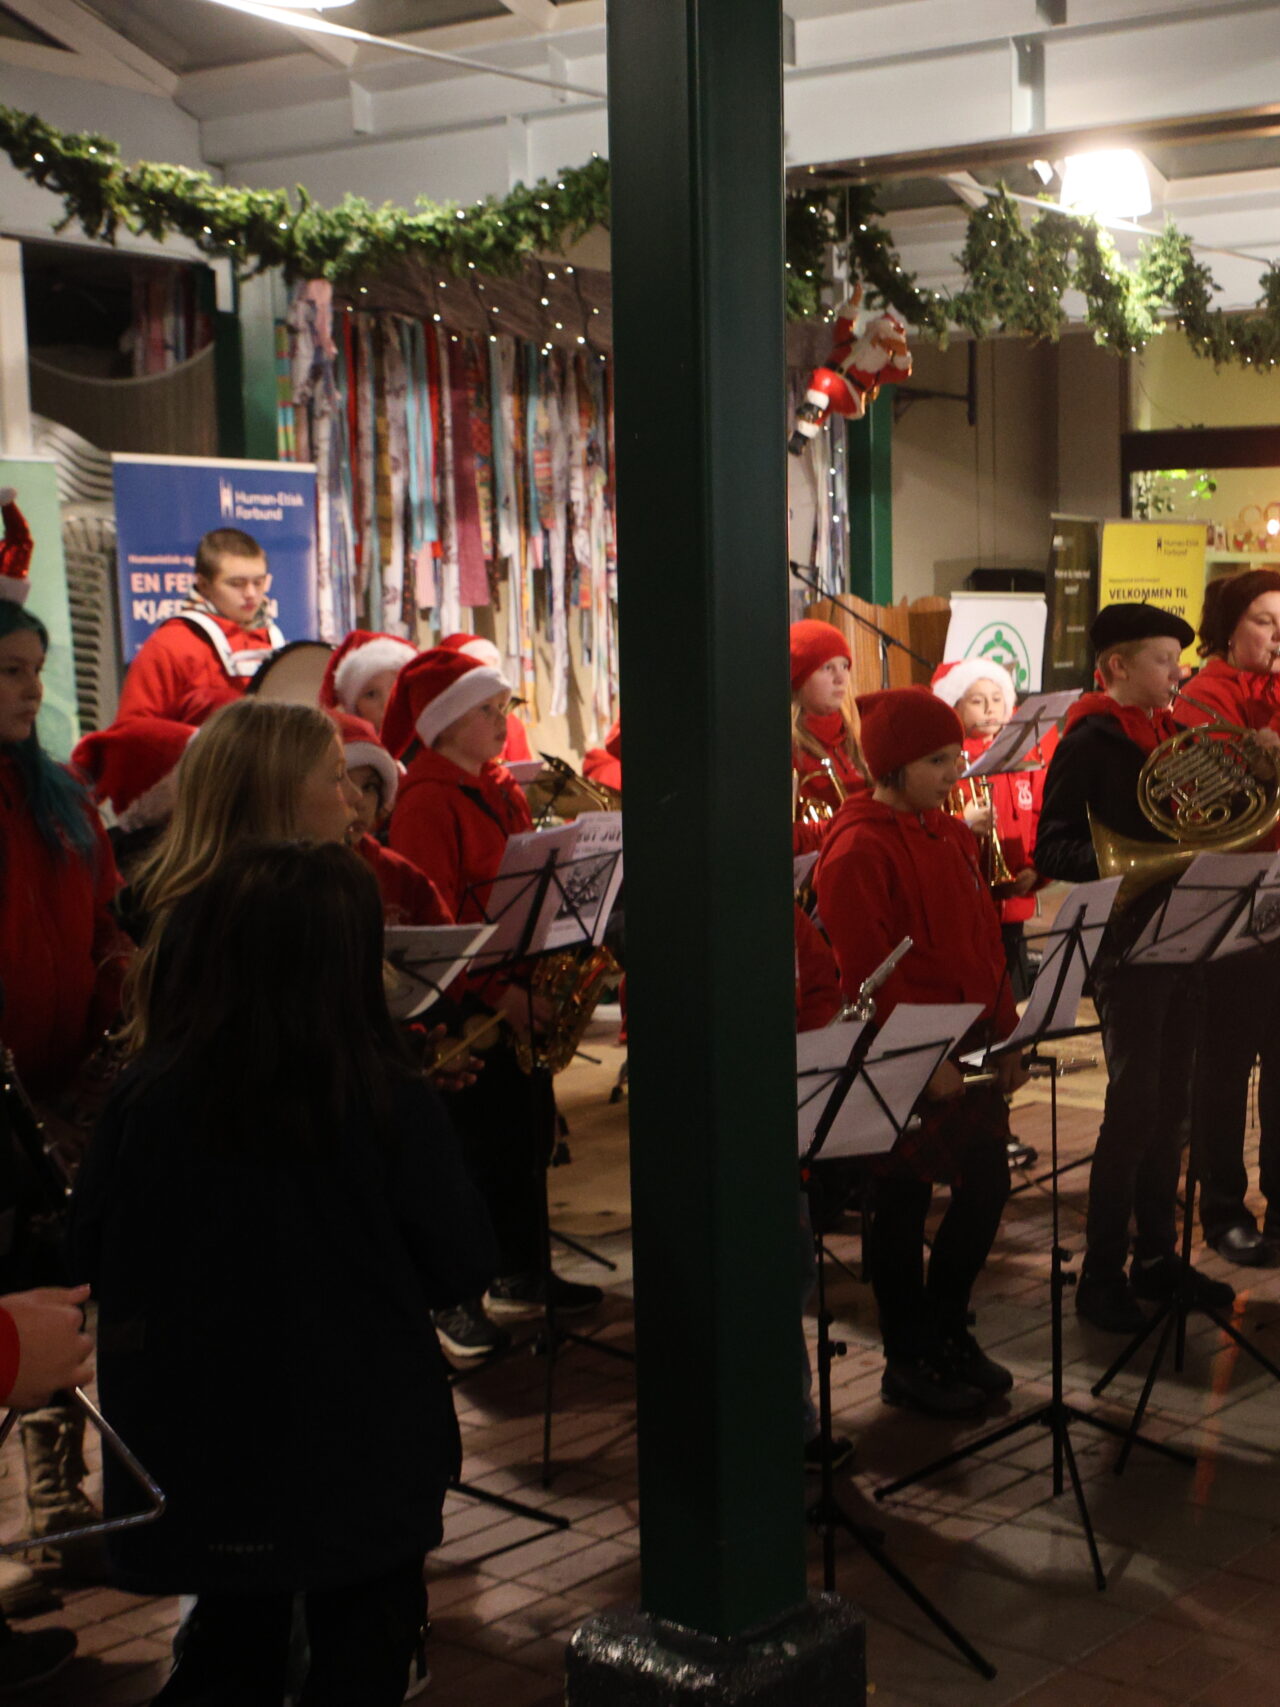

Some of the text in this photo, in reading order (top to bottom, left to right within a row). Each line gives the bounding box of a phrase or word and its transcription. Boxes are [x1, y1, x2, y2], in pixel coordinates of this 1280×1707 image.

[235, 505, 283, 521] Forbund
[130, 573, 160, 593] EN
[1109, 587, 1188, 600] VELKOMMEN TIL
